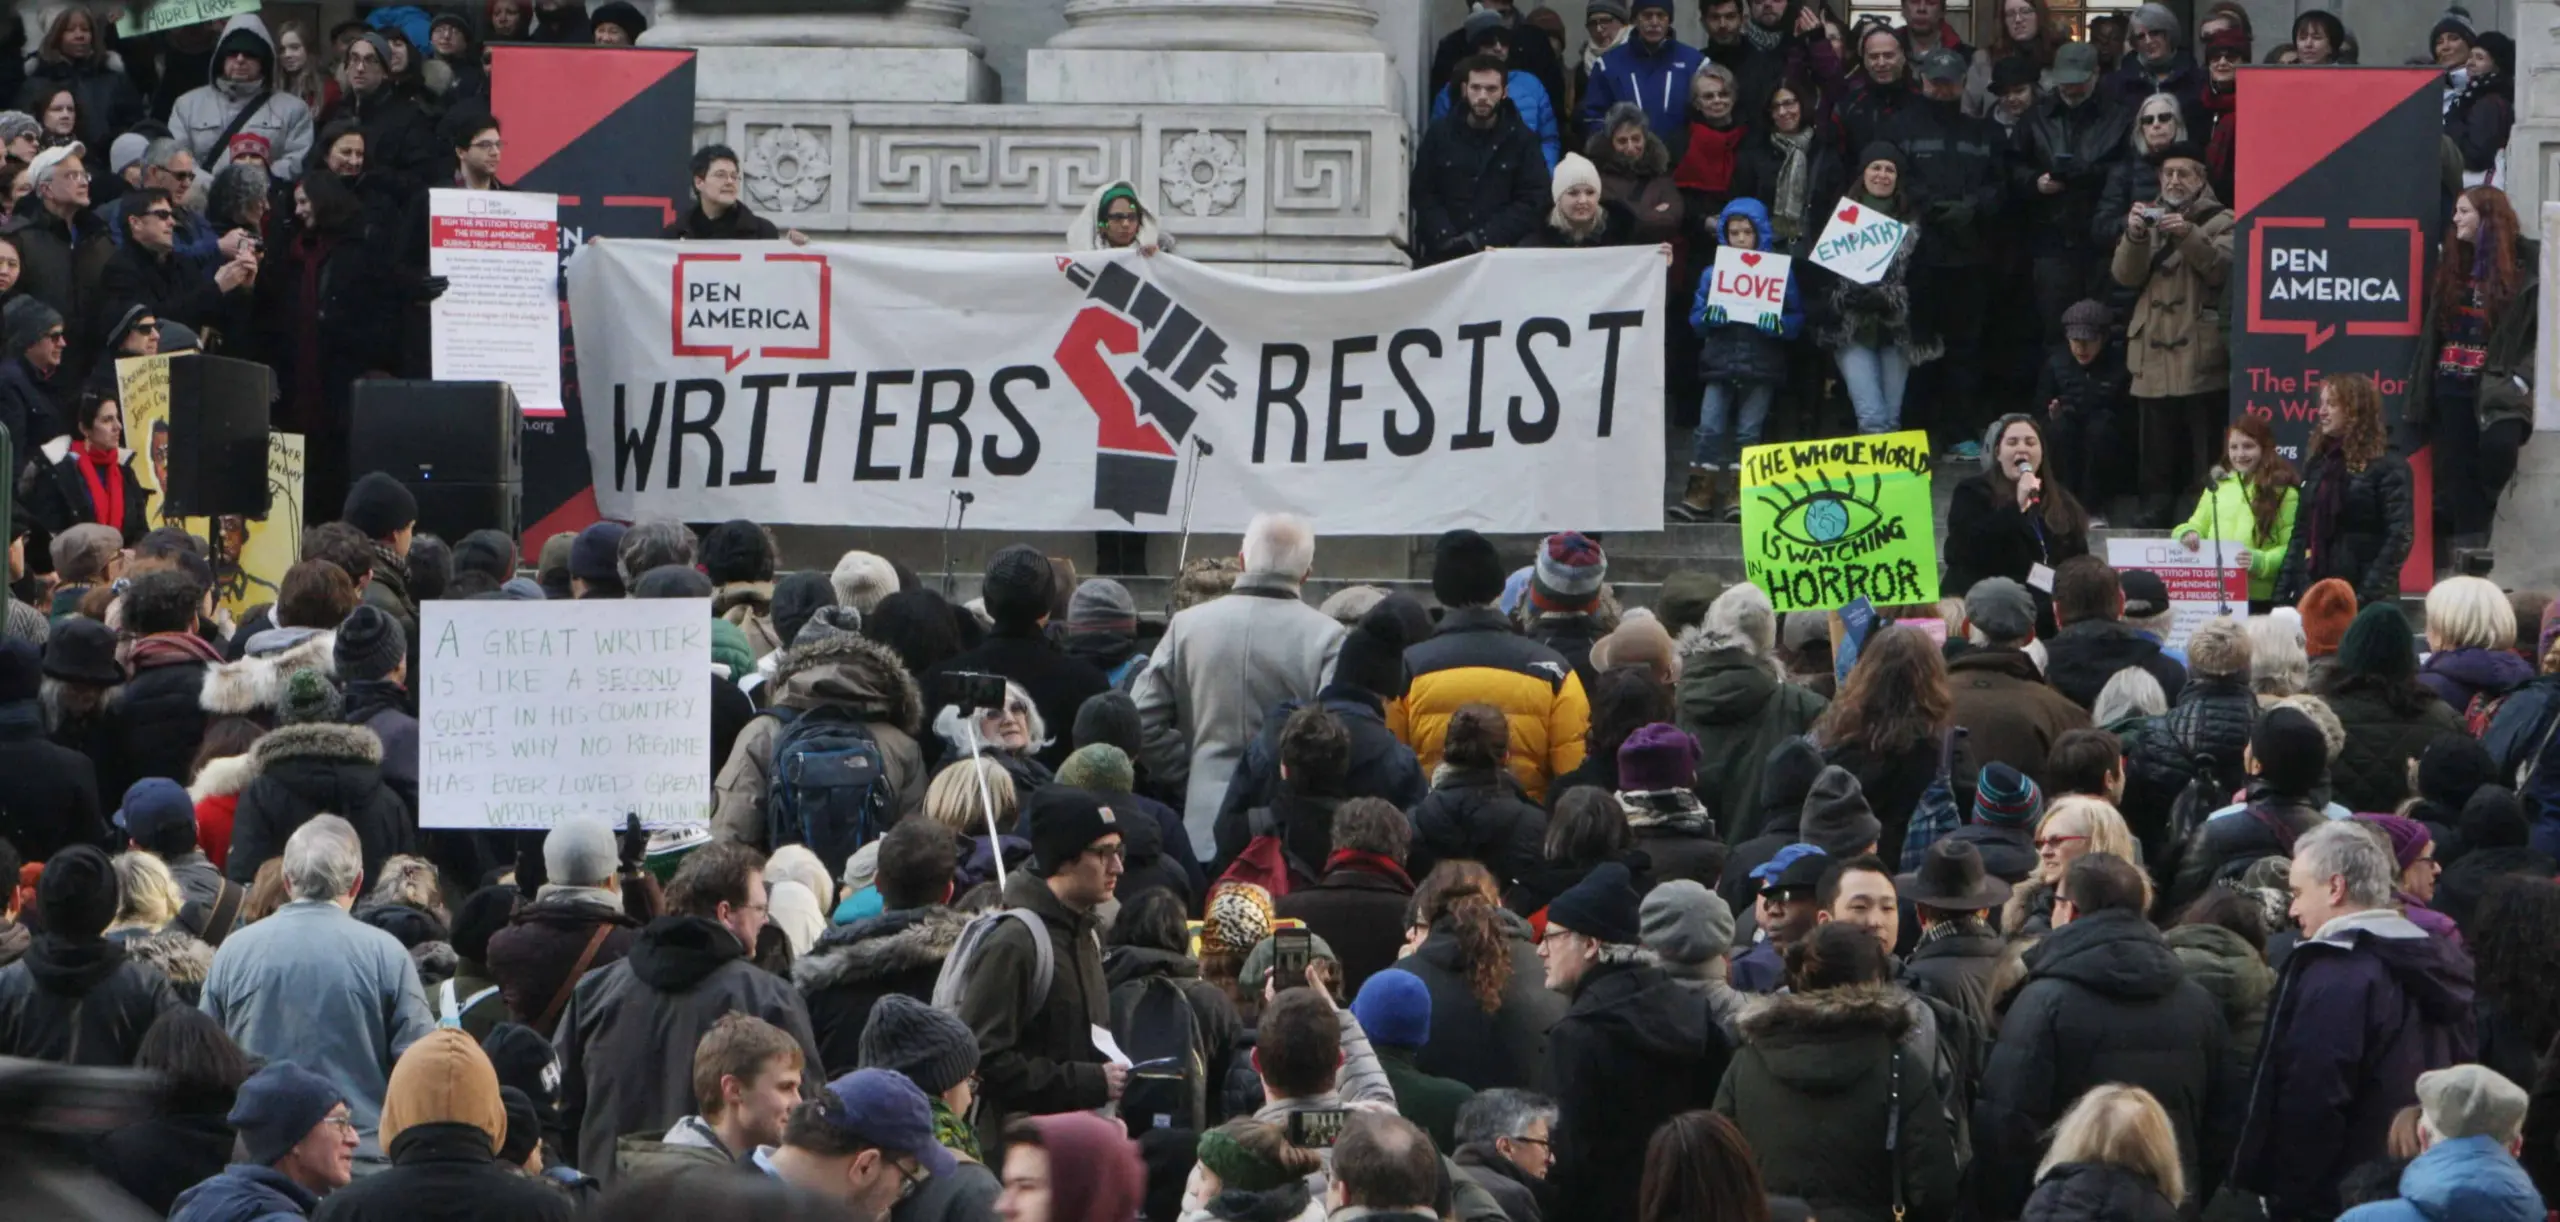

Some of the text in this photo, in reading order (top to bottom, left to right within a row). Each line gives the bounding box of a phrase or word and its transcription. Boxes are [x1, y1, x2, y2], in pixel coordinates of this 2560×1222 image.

[1816, 220, 1904, 271] EMPATHY
[2270, 248, 2328, 272] PEN
[689, 282, 742, 303] PEN
[1717, 270, 1784, 303] LOVE
[2269, 277, 2401, 301] AMERICA
[687, 308, 810, 331] AMERICA
[2247, 367, 2297, 393] The
[614, 310, 1644, 493] WRITERS RESIST
[1746, 440, 1932, 486] THE WHOLE WORLD
[1762, 516, 1908, 565] IS WATCHING
[1748, 558, 1925, 610] IN HORROR
[2192, 569, 2203, 578] TO
[435, 619, 704, 658] A GREAT WRITER
[429, 666, 683, 697] IS LIKE A SECOND
[431, 697, 695, 732] GOV'T IN HIS COUNTRY
[424, 732, 705, 769] THAT'S WHY NO REGIME
[426, 772, 708, 796] HAS EVER LOVED GREAT
